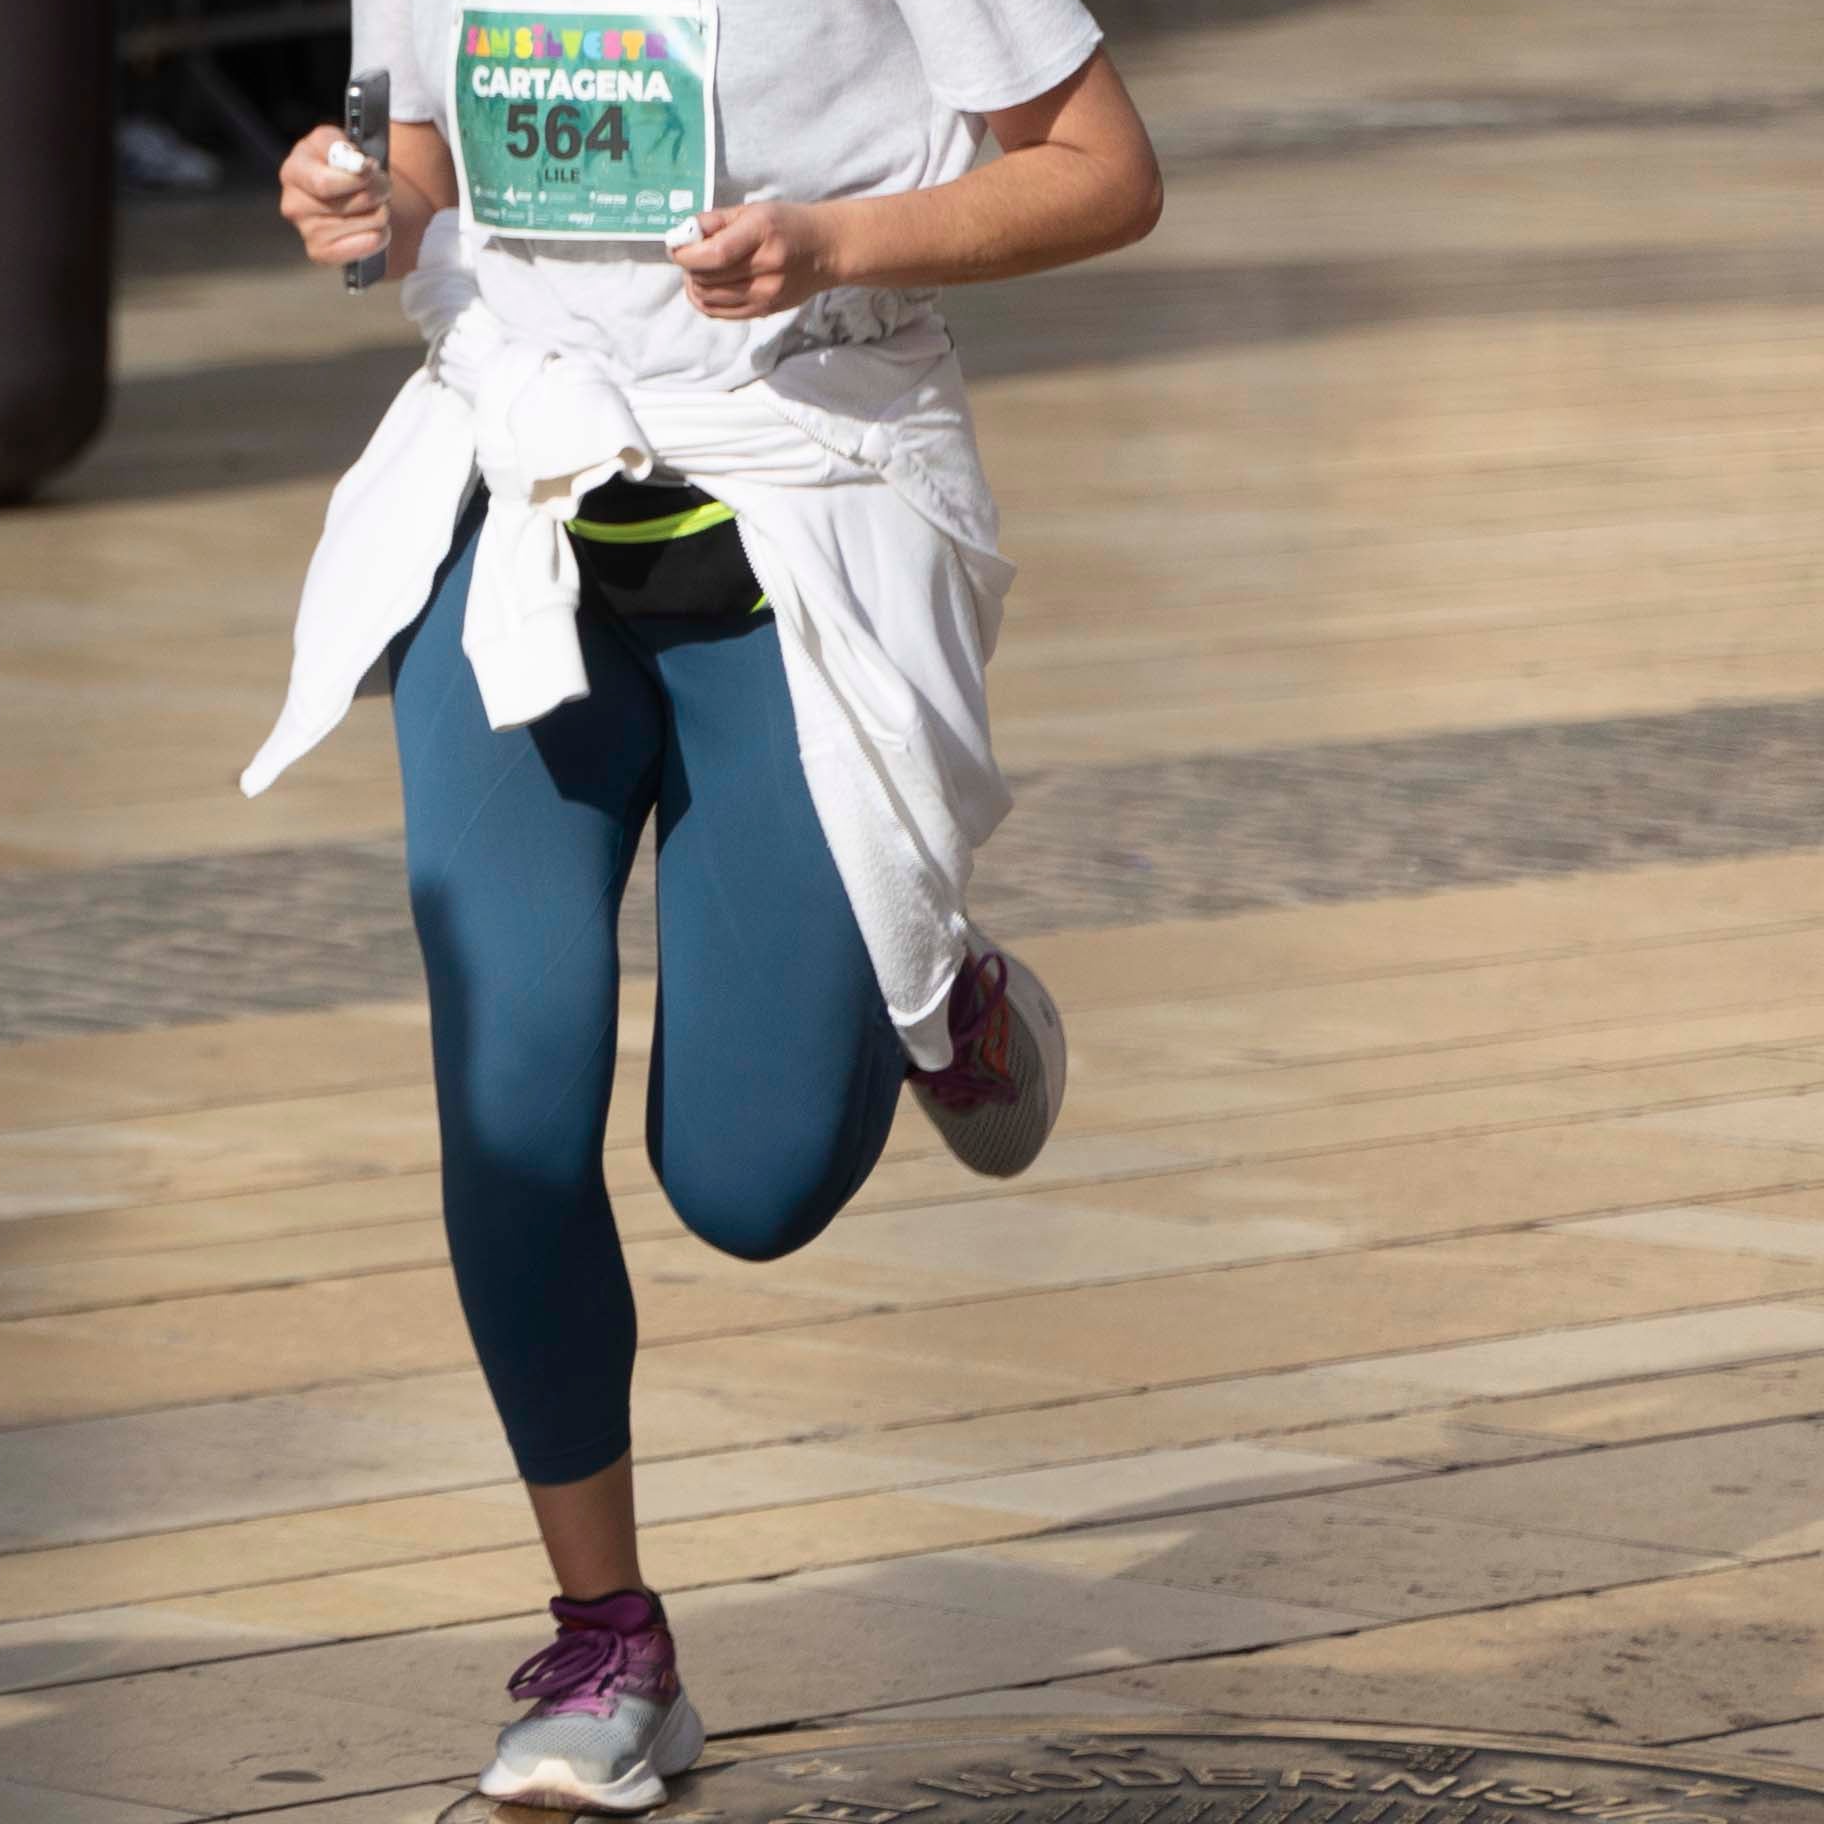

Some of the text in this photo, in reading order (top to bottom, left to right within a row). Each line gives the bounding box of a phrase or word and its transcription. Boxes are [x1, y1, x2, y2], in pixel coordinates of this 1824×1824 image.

[466, 25, 511, 57] SAN
[472, 66, 672, 102] CARTAGENA
[506, 104, 630, 161] 564
